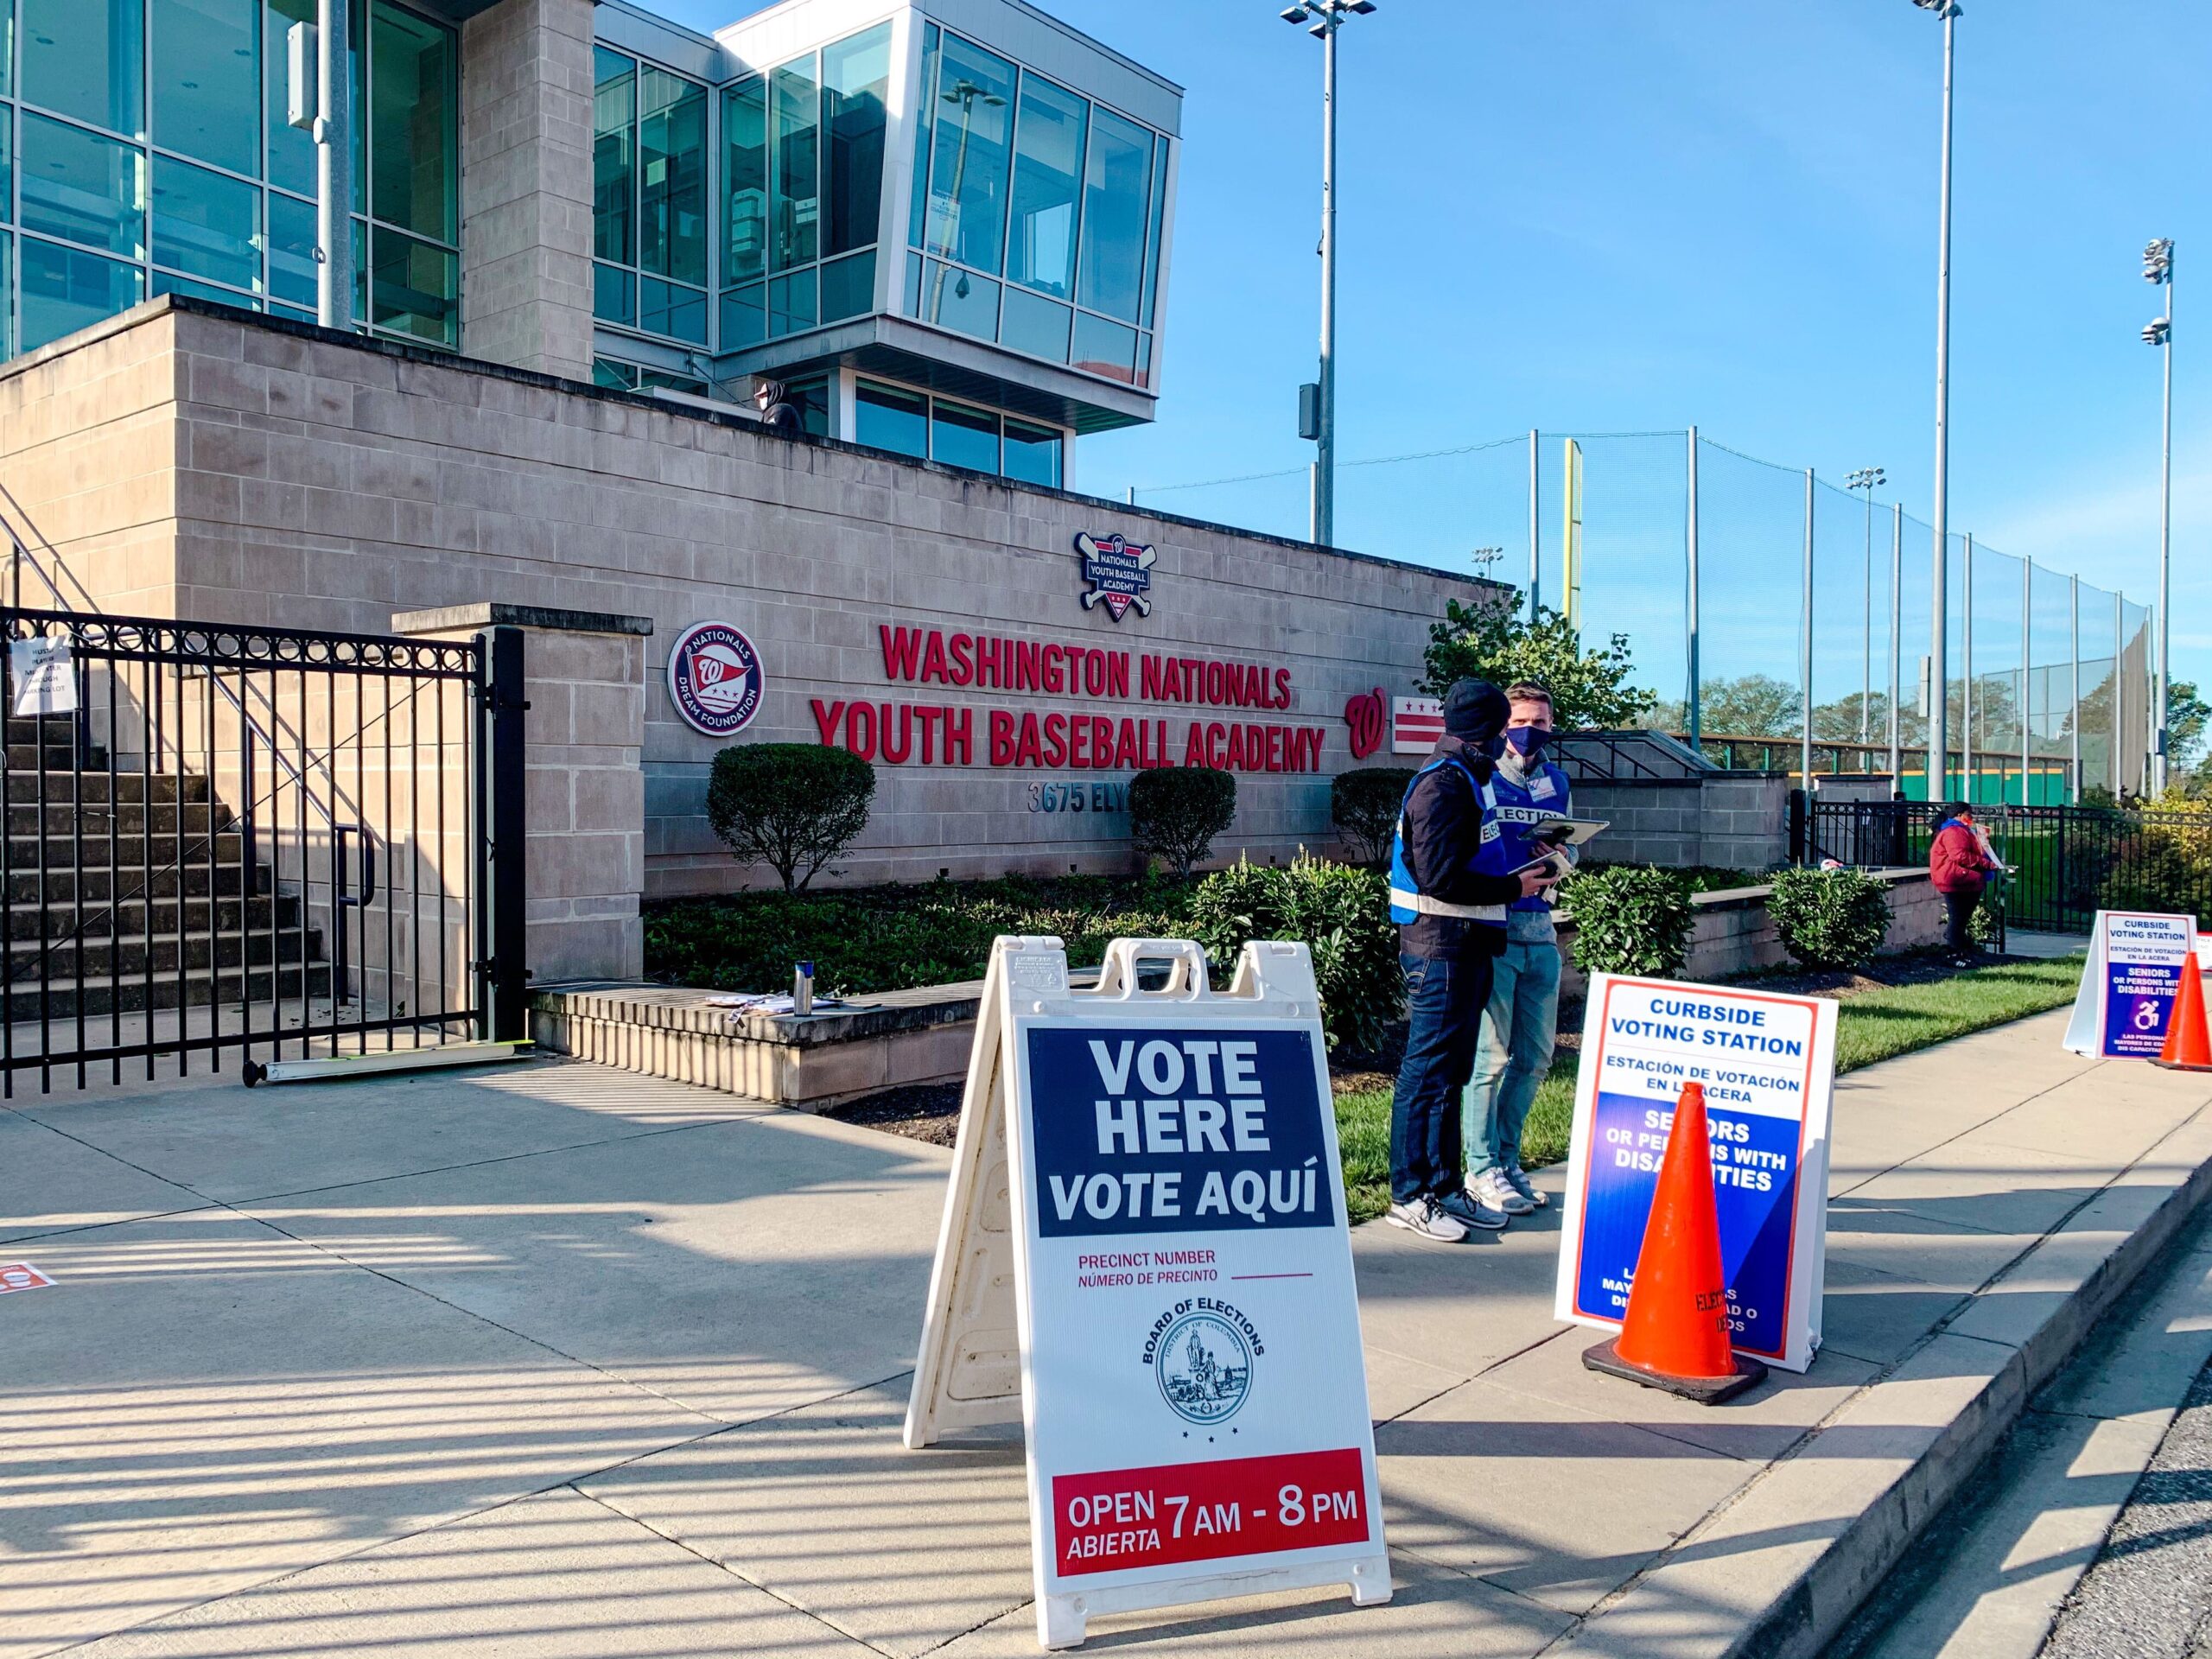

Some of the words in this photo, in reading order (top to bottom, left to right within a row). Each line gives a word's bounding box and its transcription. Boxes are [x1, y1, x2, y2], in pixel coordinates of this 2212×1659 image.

[1090, 566, 1115, 577] YOUTH
[1115, 569, 1146, 582] BASEBALL
[1100, 554, 1137, 568] NATIONALS
[1103, 580, 1135, 592] ACADEMY
[692, 631, 751, 660] NATIONALS
[879, 624, 1129, 698] WASHINGTON
[1141, 654, 1292, 709] NATIONALS
[678, 677, 701, 716] DREAM
[701, 689, 757, 728] FOUNDATION
[810, 699, 972, 765] YOUTH
[990, 709, 1174, 769] BASEBALL
[1185, 721, 1325, 772] ACADEMY
[1027, 781, 1085, 813] 3675
[1496, 808, 1559, 822] LECTIO
[2110, 930, 2145, 938] VOTING
[2146, 931, 2186, 941] STATION
[2124, 920, 2171, 930] CURBSIDE
[2126, 977, 2164, 986] PERSONS
[2128, 967, 2171, 978] SENIORS
[2117, 985, 2178, 996] DISABILITIES
[1649, 999, 1766, 1027] CURBSIDE
[1611, 1018, 1695, 1042] VOTING
[1701, 1029, 1802, 1057] STATION
[1088, 1039, 1263, 1096] VOTE
[1606, 1055, 1685, 1076] ESTACIÓN
[1689, 1067, 1711, 1080] DE
[1715, 1070, 1801, 1093] VOTACIÓN
[1647, 1077, 1668, 1090] EN
[1095, 1099, 1271, 1154] HERE
[1644, 1109, 1751, 1143] SEORS
[1605, 1128, 1633, 1146] OR
[1733, 1147, 1787, 1172] WITH
[1048, 1172, 1183, 1221] VOTE
[1195, 1155, 1319, 1223] AQUÍ
[1078, 1252, 1150, 1269] PRECINCT
[1154, 1249, 1216, 1266] NUMBER
[1078, 1273, 1135, 1288] NÚMERO
[1137, 1272, 1154, 1285] DE
[1157, 1268, 1218, 1284] PRECINTO
[1611, 1294, 1630, 1308] DI
[1745, 1307, 1758, 1319] O
[1142, 1311, 1173, 1365] BOARD
[1174, 1299, 1193, 1315] OF
[1198, 1297, 1265, 1357] ELECTIONS
[1165, 1325, 1190, 1358] DISTRICT
[1192, 1320, 1203, 1329] OF
[1206, 1321, 1241, 1354] COLUMBIA
[1068, 1489, 1155, 1528] OPEN
[1065, 1528, 1161, 1560] ABIERTA
